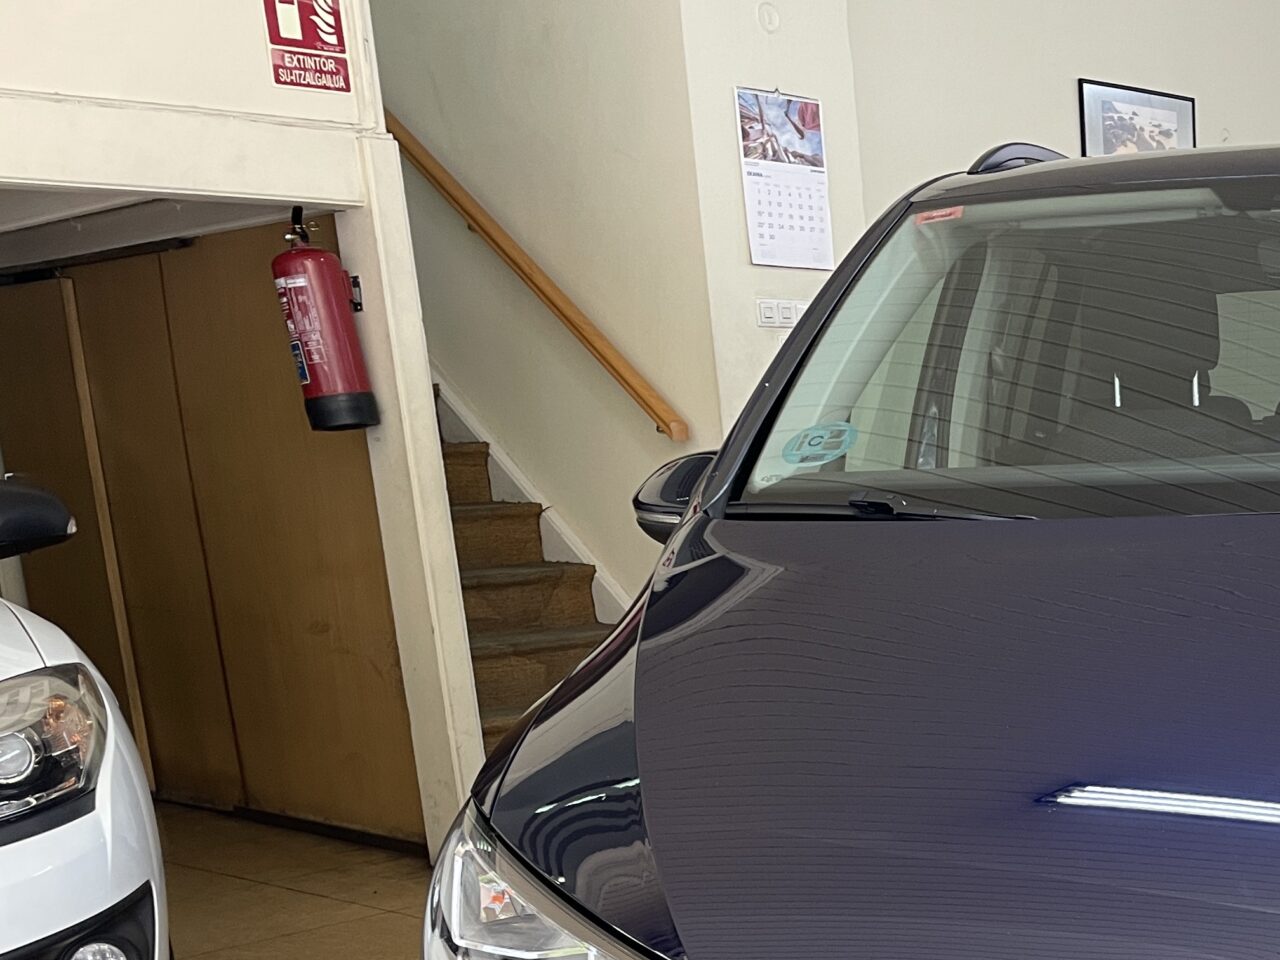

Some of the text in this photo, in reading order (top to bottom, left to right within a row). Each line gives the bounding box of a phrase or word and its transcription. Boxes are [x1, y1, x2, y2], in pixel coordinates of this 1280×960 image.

[285, 53, 336, 72] EXTINTOR
[278, 68, 346, 89] SU-ITZALGAILUA
[808, 435, 824, 447] C
